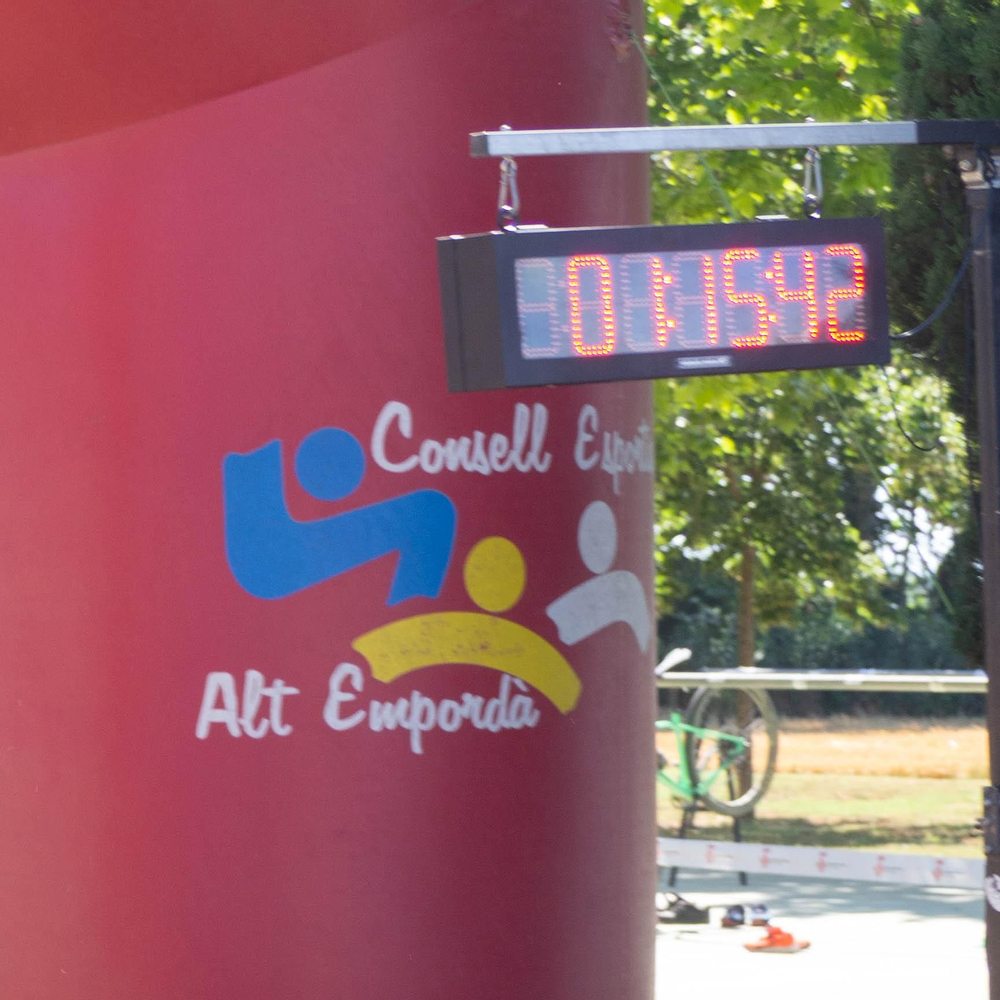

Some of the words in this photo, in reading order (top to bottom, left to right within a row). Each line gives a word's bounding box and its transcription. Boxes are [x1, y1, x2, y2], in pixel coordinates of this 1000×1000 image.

[566, 243, 867, 357] 01:15:42
[371, 400, 552, 476] Consell
[195, 669, 300, 740] Alt
[324, 662, 541, 755] Empordà
